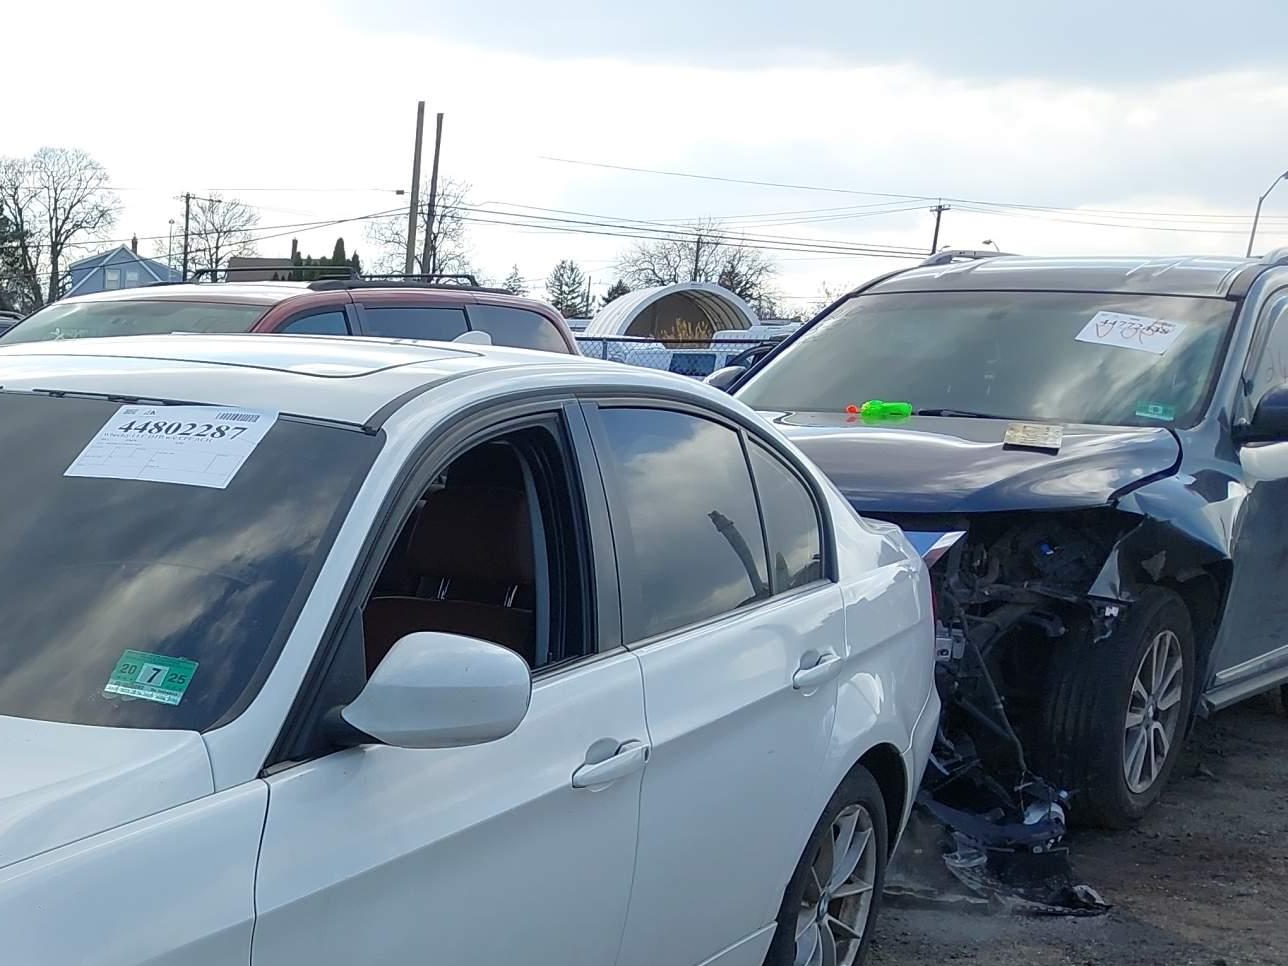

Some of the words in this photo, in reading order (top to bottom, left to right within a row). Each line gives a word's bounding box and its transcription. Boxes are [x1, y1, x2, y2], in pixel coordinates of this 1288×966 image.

[118, 420, 248, 440] 44802287
[120, 663, 137, 675] 20
[147, 667, 162, 683] 7
[168, 673, 187, 685] 25
